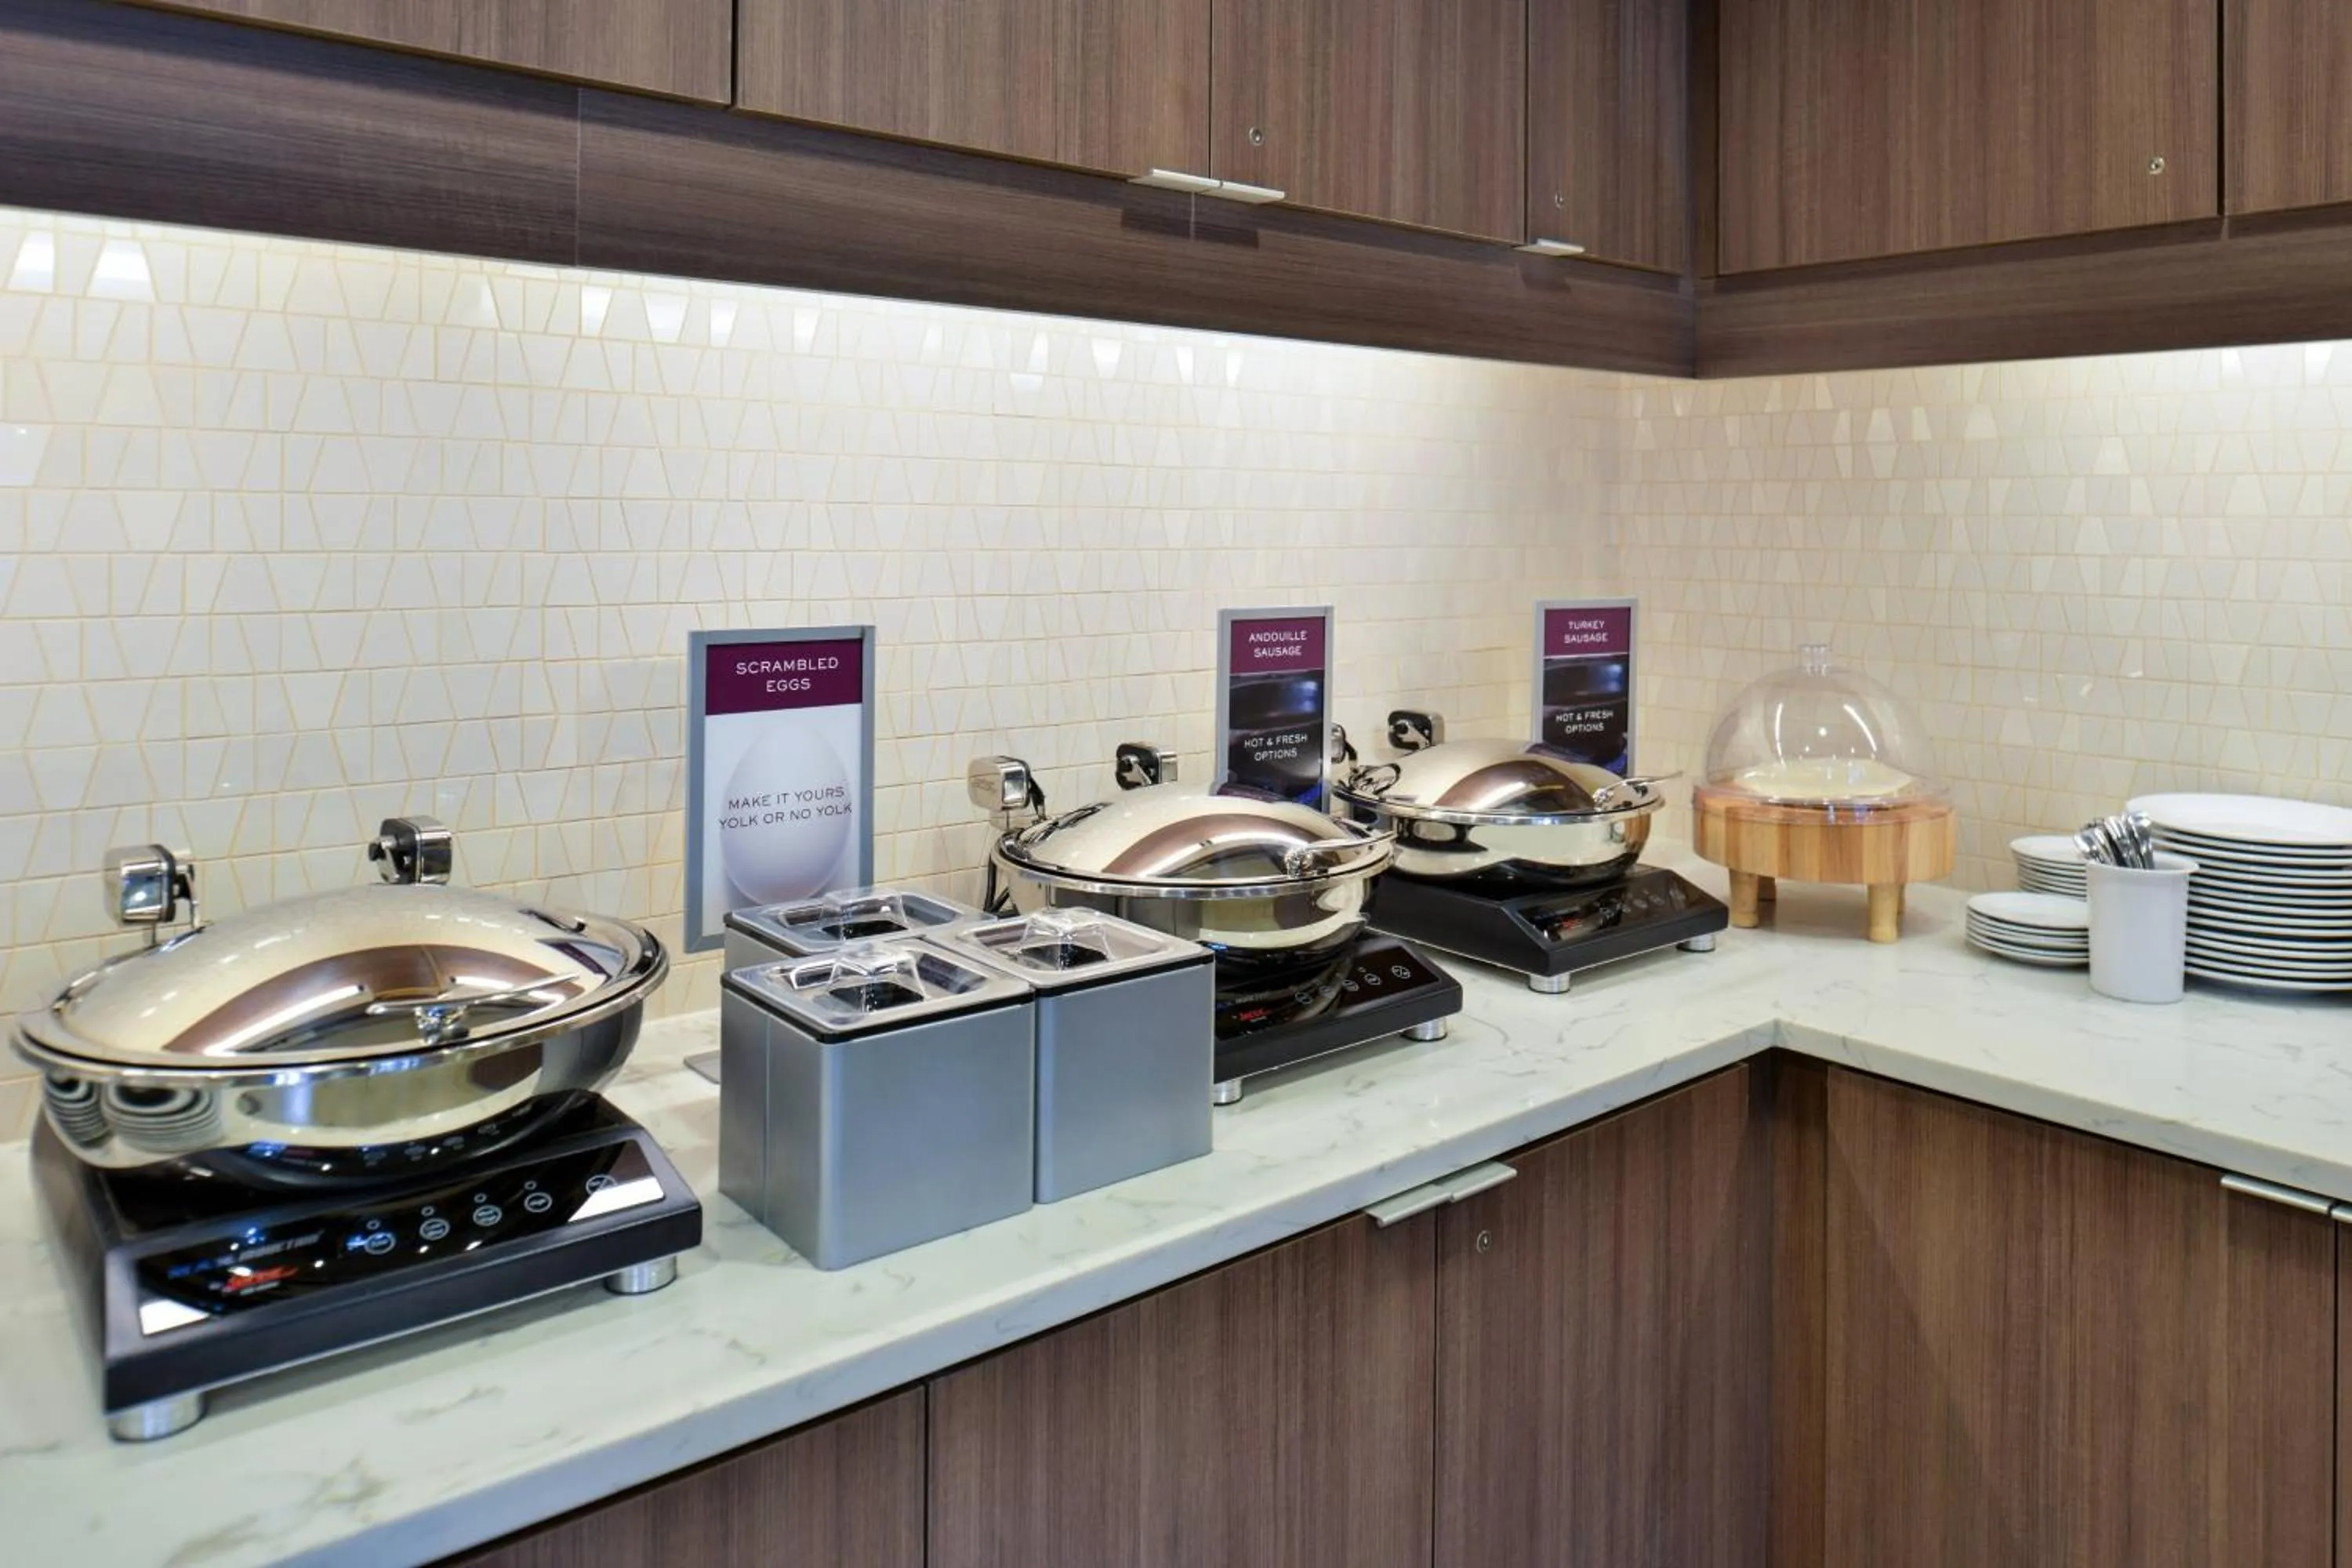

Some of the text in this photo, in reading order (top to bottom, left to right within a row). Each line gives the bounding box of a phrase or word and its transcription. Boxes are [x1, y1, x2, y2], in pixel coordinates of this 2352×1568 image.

[1568, 620, 1605, 630] TURKEY
[1248, 630, 1308, 643] ANDOUILLE
[1564, 632, 1608, 644] SAUSAGE
[1254, 645, 1302, 658] SAUSAGE
[735, 657, 839, 675] SCRAMBLED
[766, 678, 811, 692] EGGS
[1555, 713, 1573, 722] HOT
[1584, 710, 1614, 720] FRESH
[1565, 722, 1605, 734] OPTIONS
[1244, 738, 1263, 749] HOT
[1276, 733, 1308, 745] FRESH
[1254, 747, 1298, 761] OPTIONS
[728, 786, 845, 811] MAKE IT YOURS
[719, 802, 852, 829] YOLK OR NO YOLK
